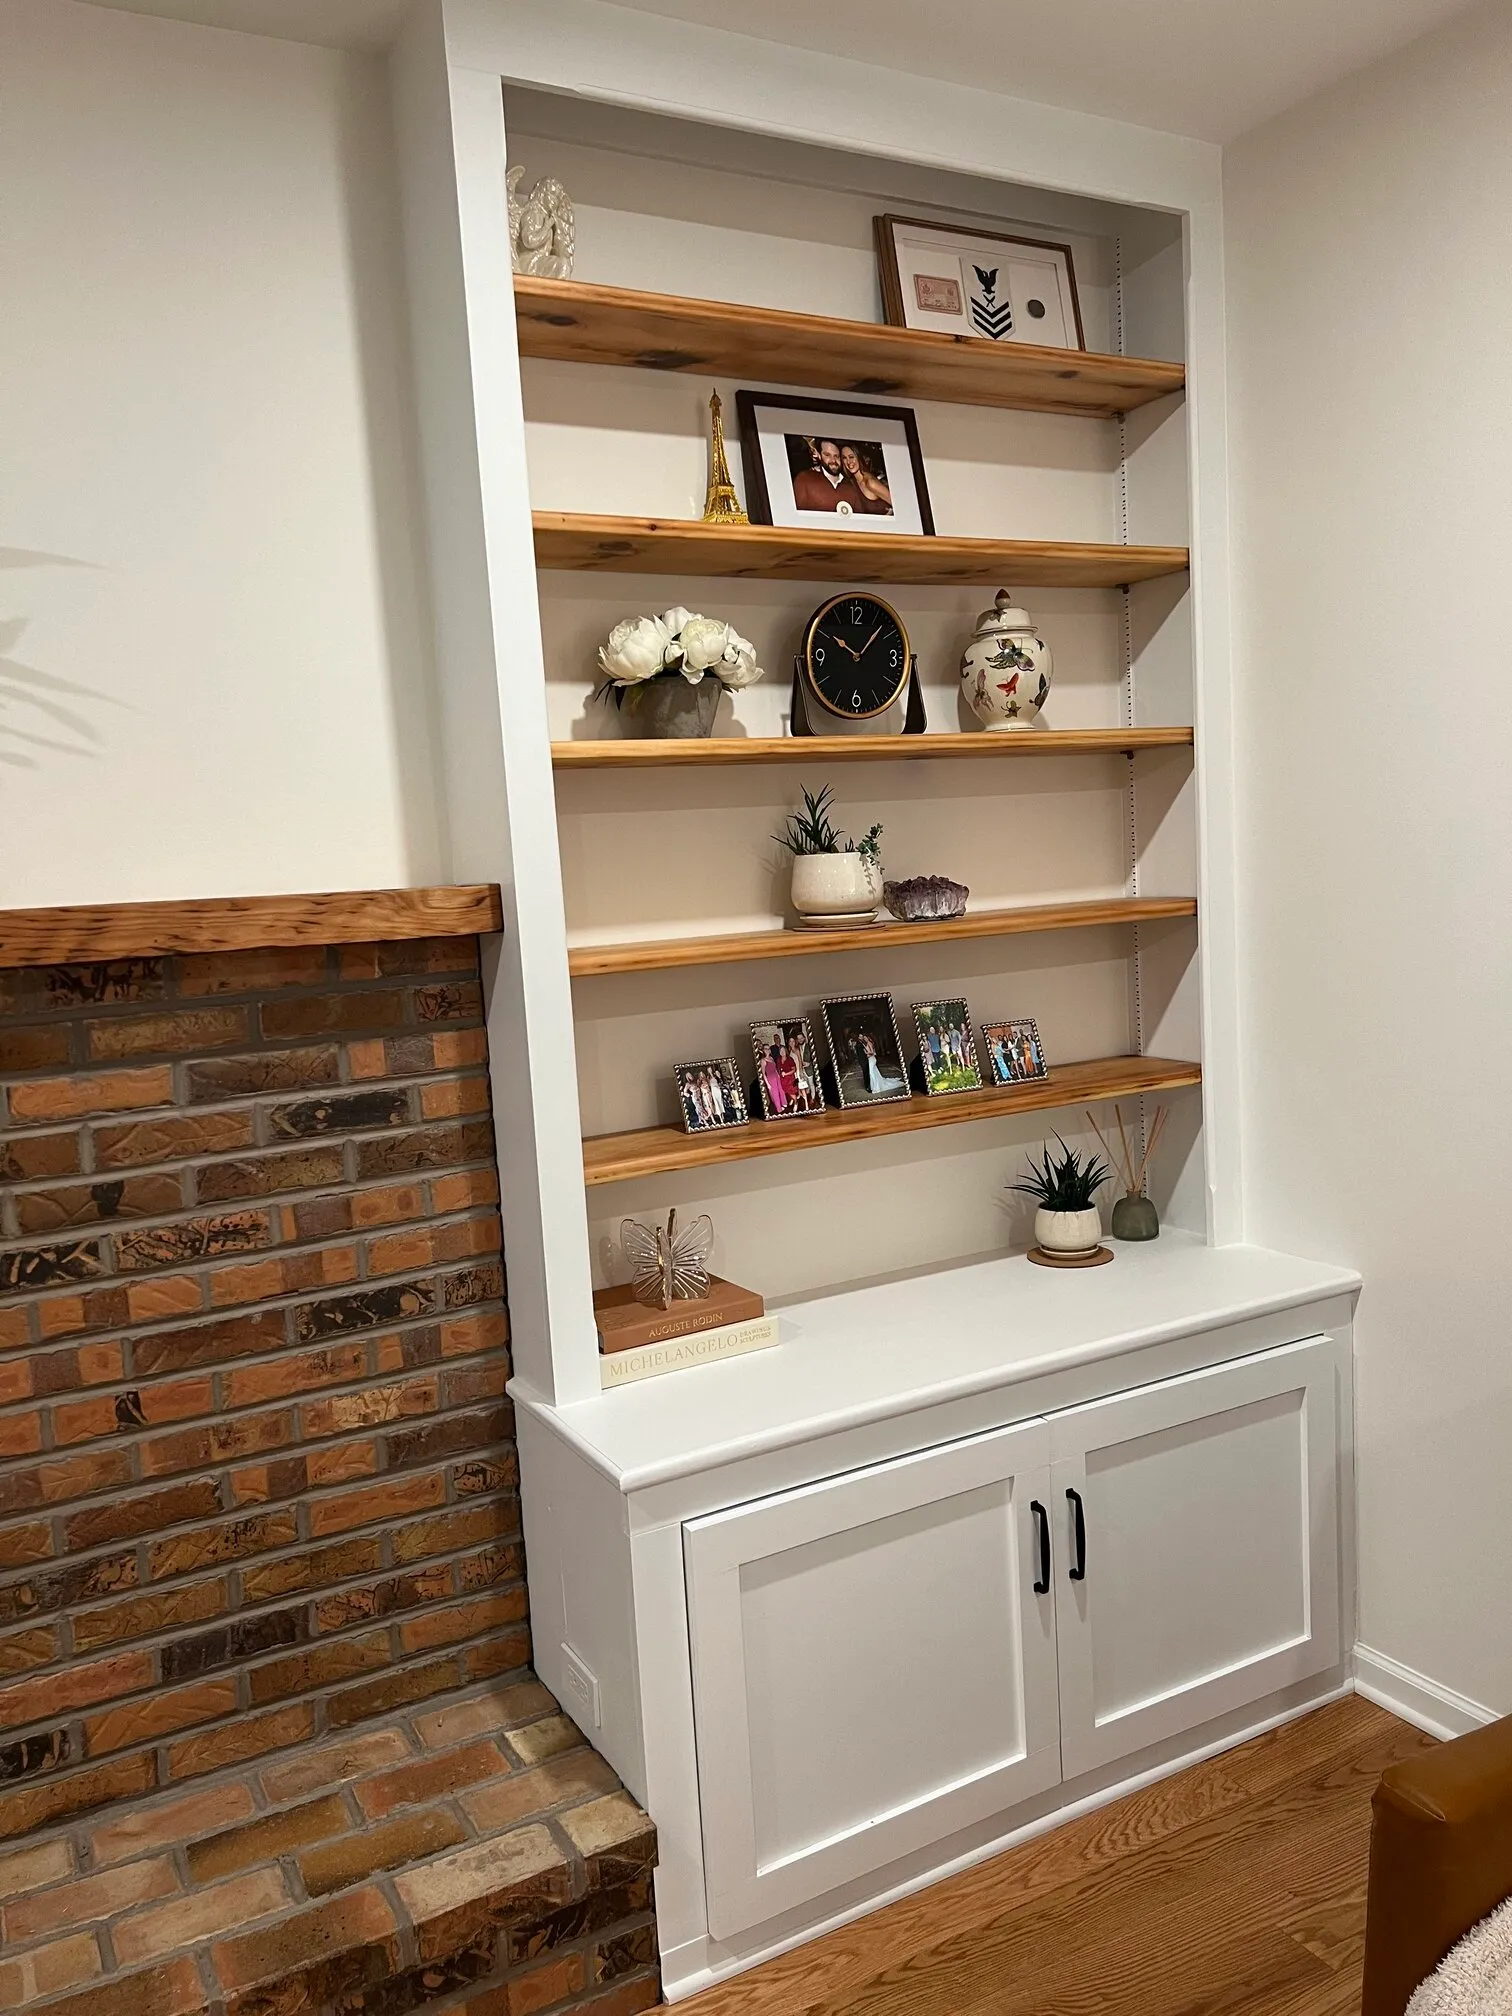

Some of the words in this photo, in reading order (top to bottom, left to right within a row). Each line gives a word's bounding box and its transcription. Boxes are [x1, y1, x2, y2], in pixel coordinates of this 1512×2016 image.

[849, 606, 863, 625] 12
[815, 648, 826, 666] 9
[889, 649, 898, 667] 3
[851, 689, 862, 707] 6
[648, 1321, 691, 1338] AUGUSTE
[692, 1312, 724, 1327] RODIN
[610, 1334, 738, 1377] MICHELANGELO
